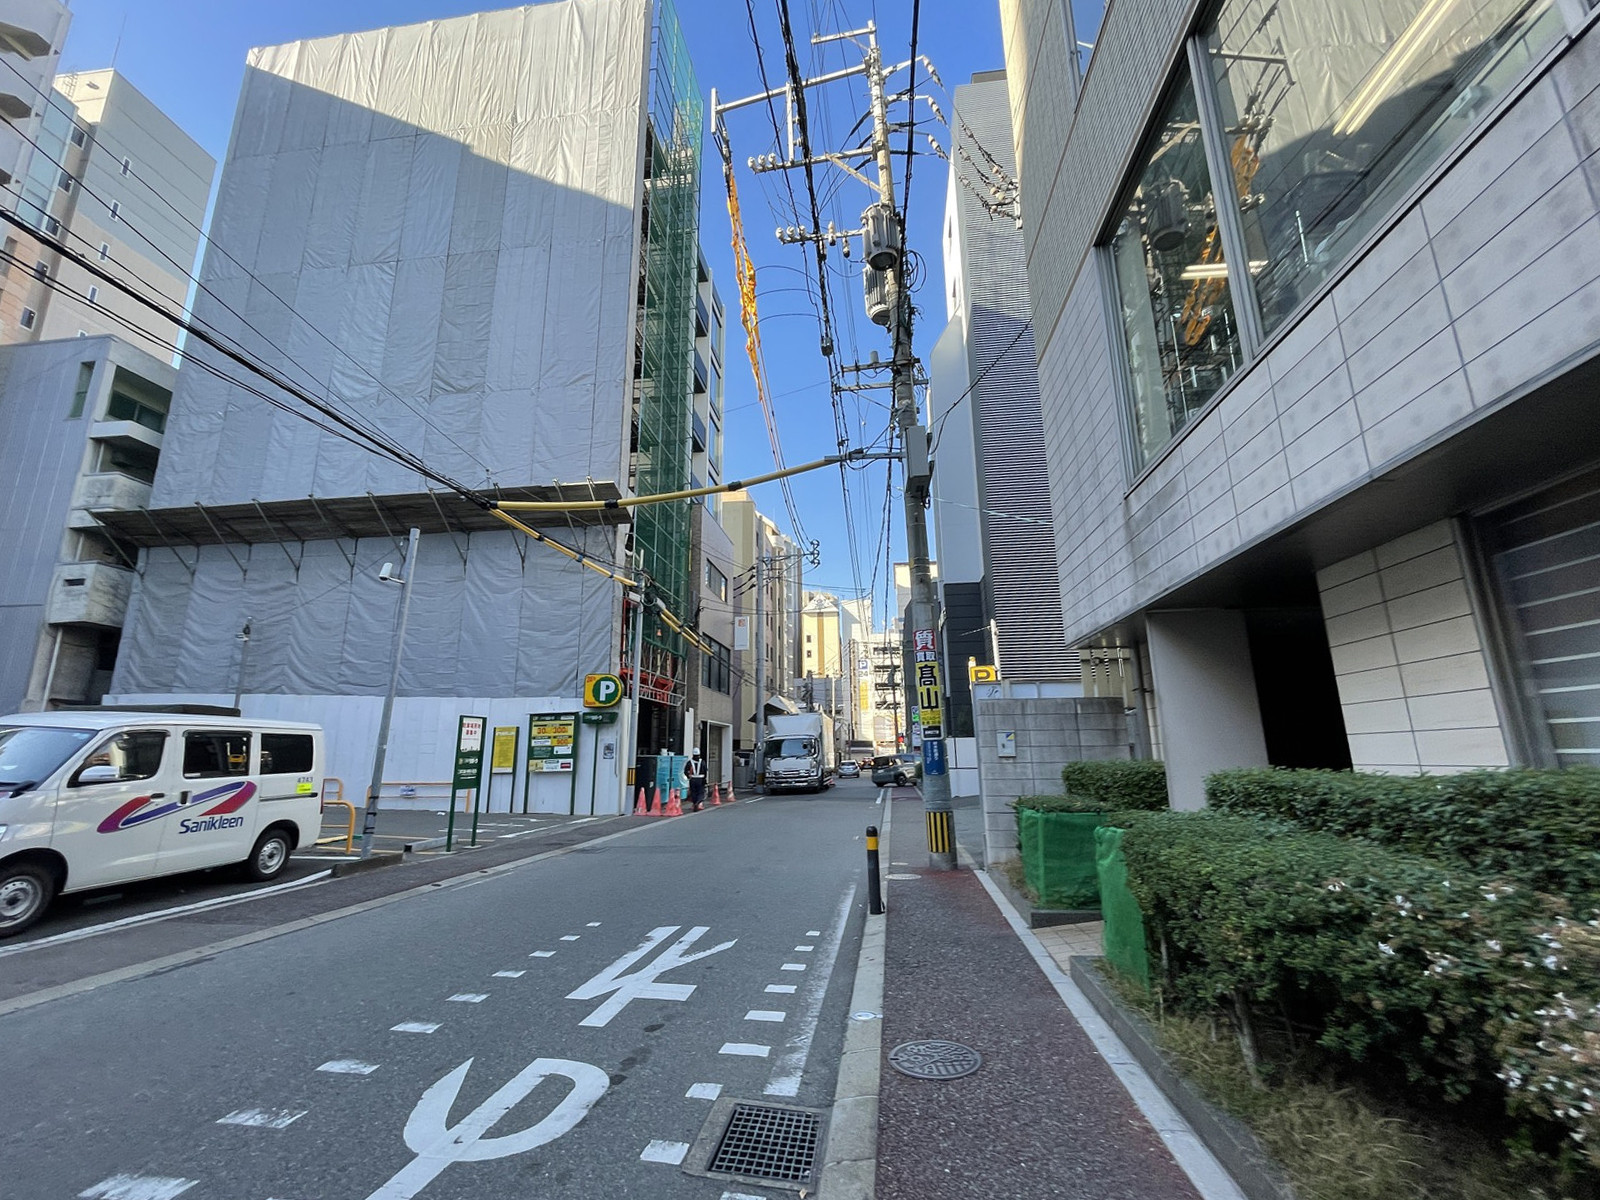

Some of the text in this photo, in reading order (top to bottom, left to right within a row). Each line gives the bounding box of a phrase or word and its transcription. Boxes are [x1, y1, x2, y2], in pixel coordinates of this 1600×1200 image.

[916, 630, 934, 650] 質
[975, 670, 991, 682] P
[600, 681, 615, 701] P
[919, 665, 939, 709] 高山
[178, 816, 244, 834] Sanikleen
